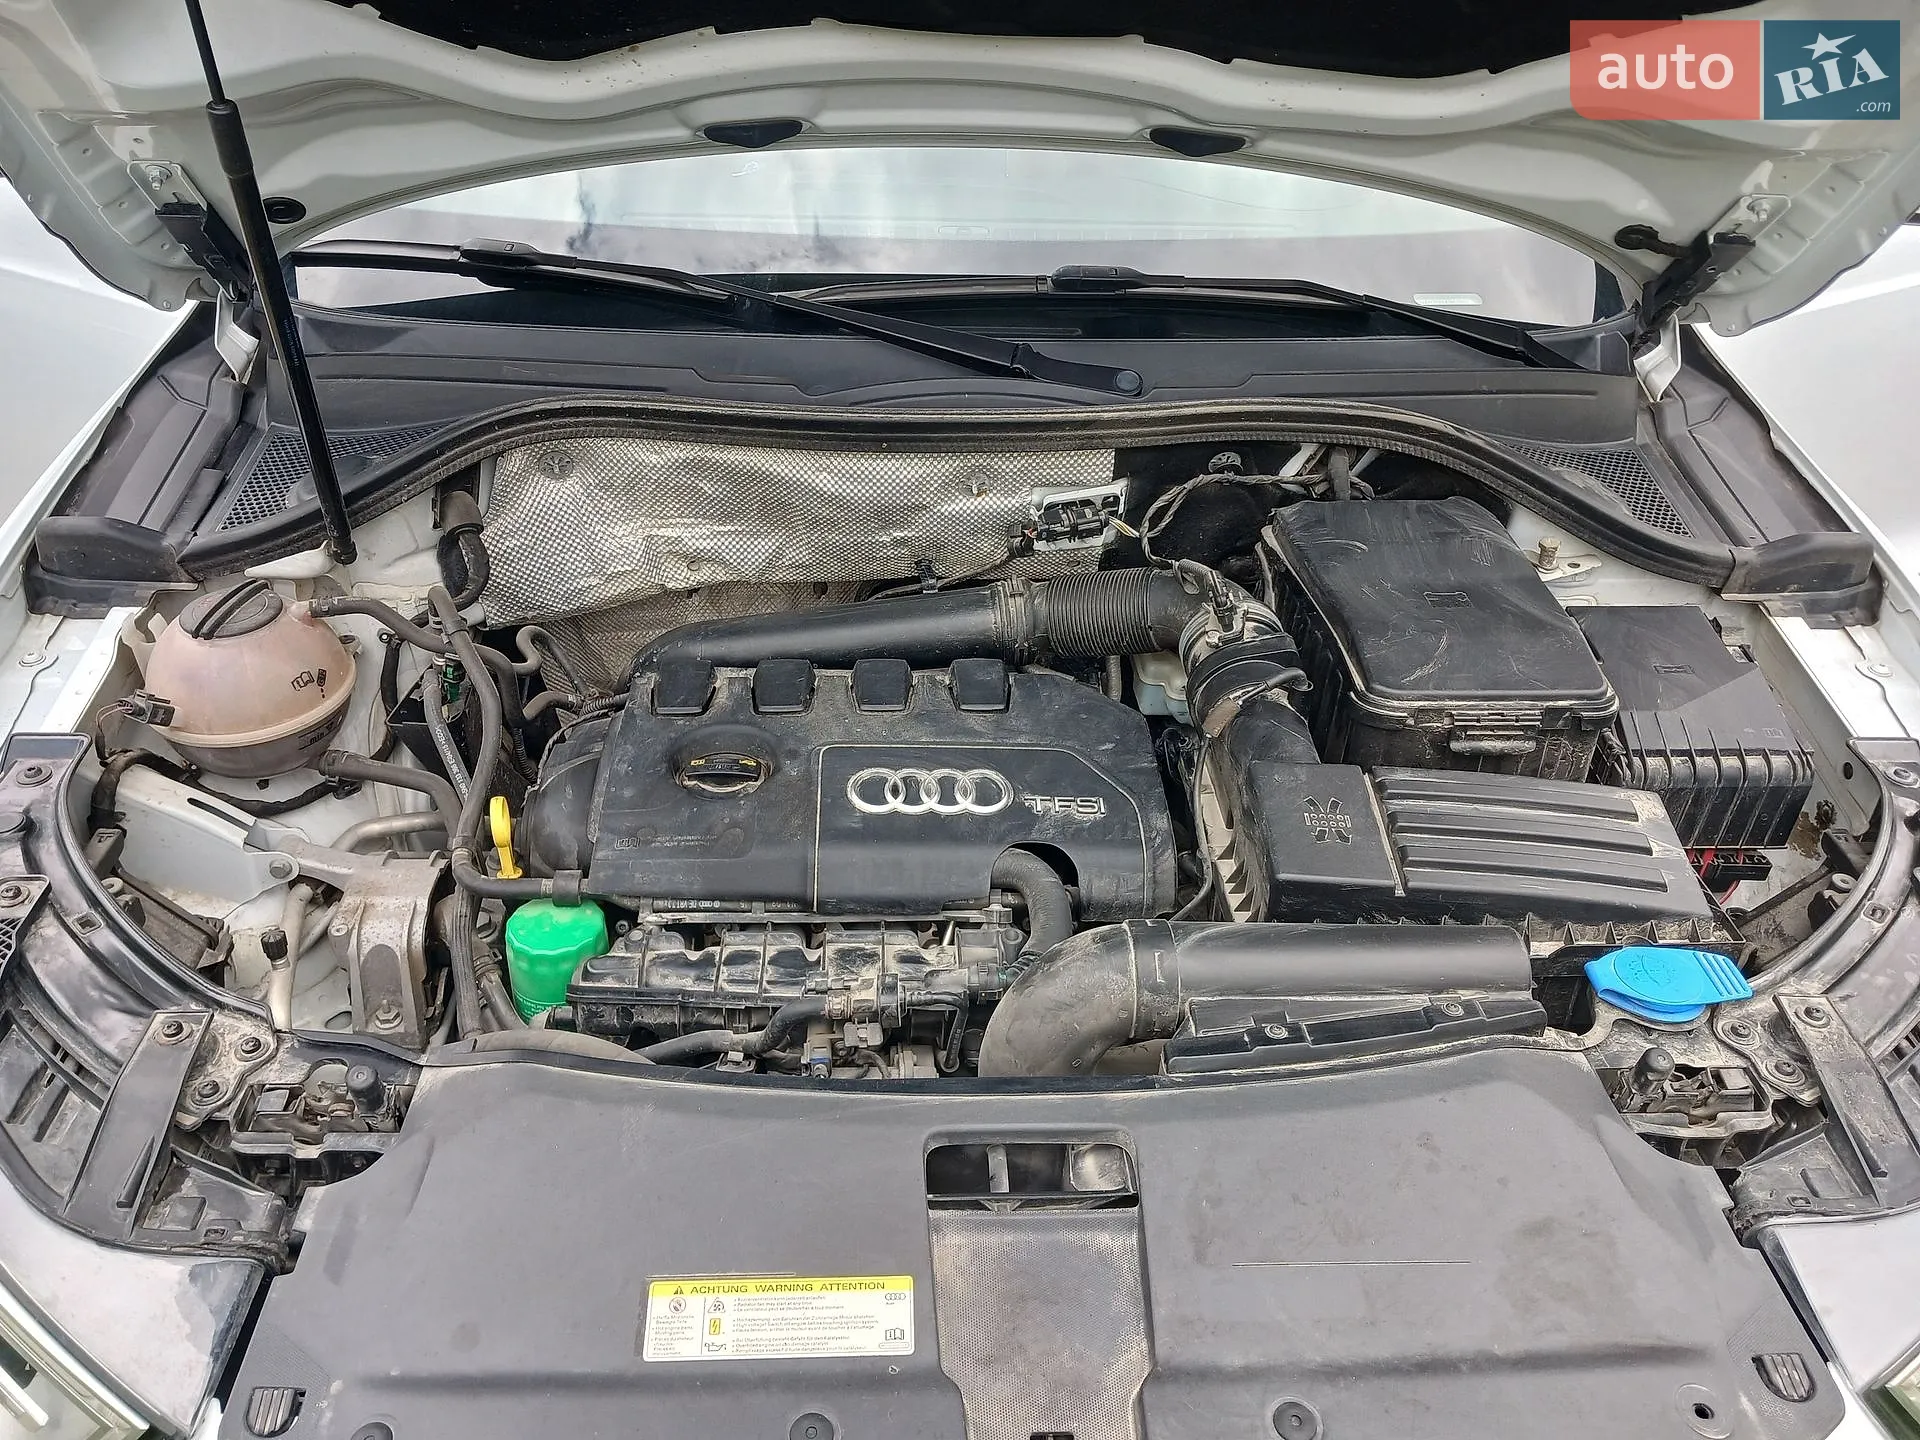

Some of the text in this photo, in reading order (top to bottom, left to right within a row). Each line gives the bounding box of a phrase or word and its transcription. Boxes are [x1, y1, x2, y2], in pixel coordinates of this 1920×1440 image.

[1023, 796, 1106, 816] TFSI
[690, 1281, 886, 1295] ACHTUNG WARNING ATTENTION
